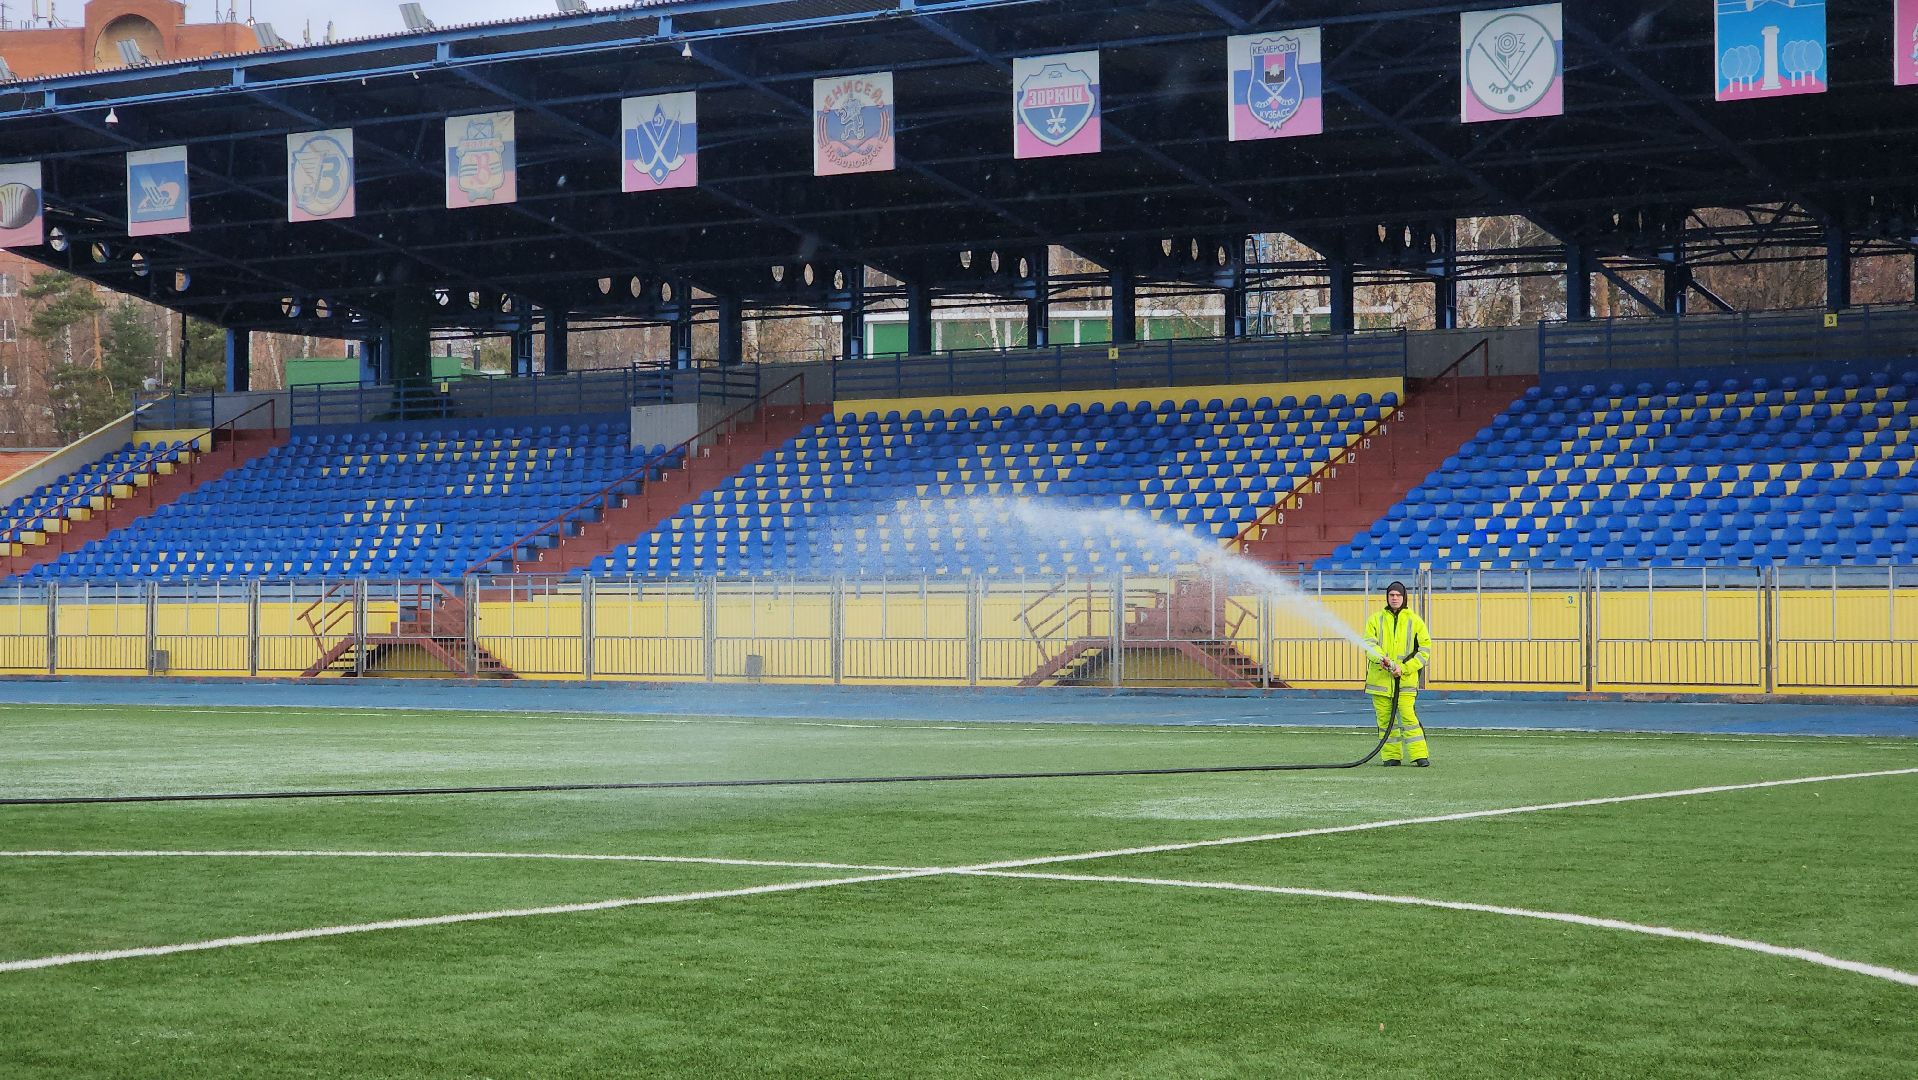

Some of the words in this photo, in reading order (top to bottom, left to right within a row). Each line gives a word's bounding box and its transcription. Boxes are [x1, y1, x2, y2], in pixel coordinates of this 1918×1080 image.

[1252, 43, 1297, 55] КЕМЕРОВО
[1259, 108, 1291, 119] КУЗБАСС
[1397, 410, 1405, 422] 15
[1379, 424, 1387, 436] 14
[1363, 438, 1371, 449] 13
[1347, 452, 1356, 464] 12
[1331, 467, 1337, 478] 11
[1314, 481, 1321, 494] 10
[1297, 497, 1303, 509] 9
[1277, 513, 1284, 525] 8
[1261, 529, 1268, 540] 7
[538, 553, 544, 562] 6
[516, 564, 520, 573] 5
[1158, 598, 1165, 609] 2
[1567, 595, 1574, 604] 3
